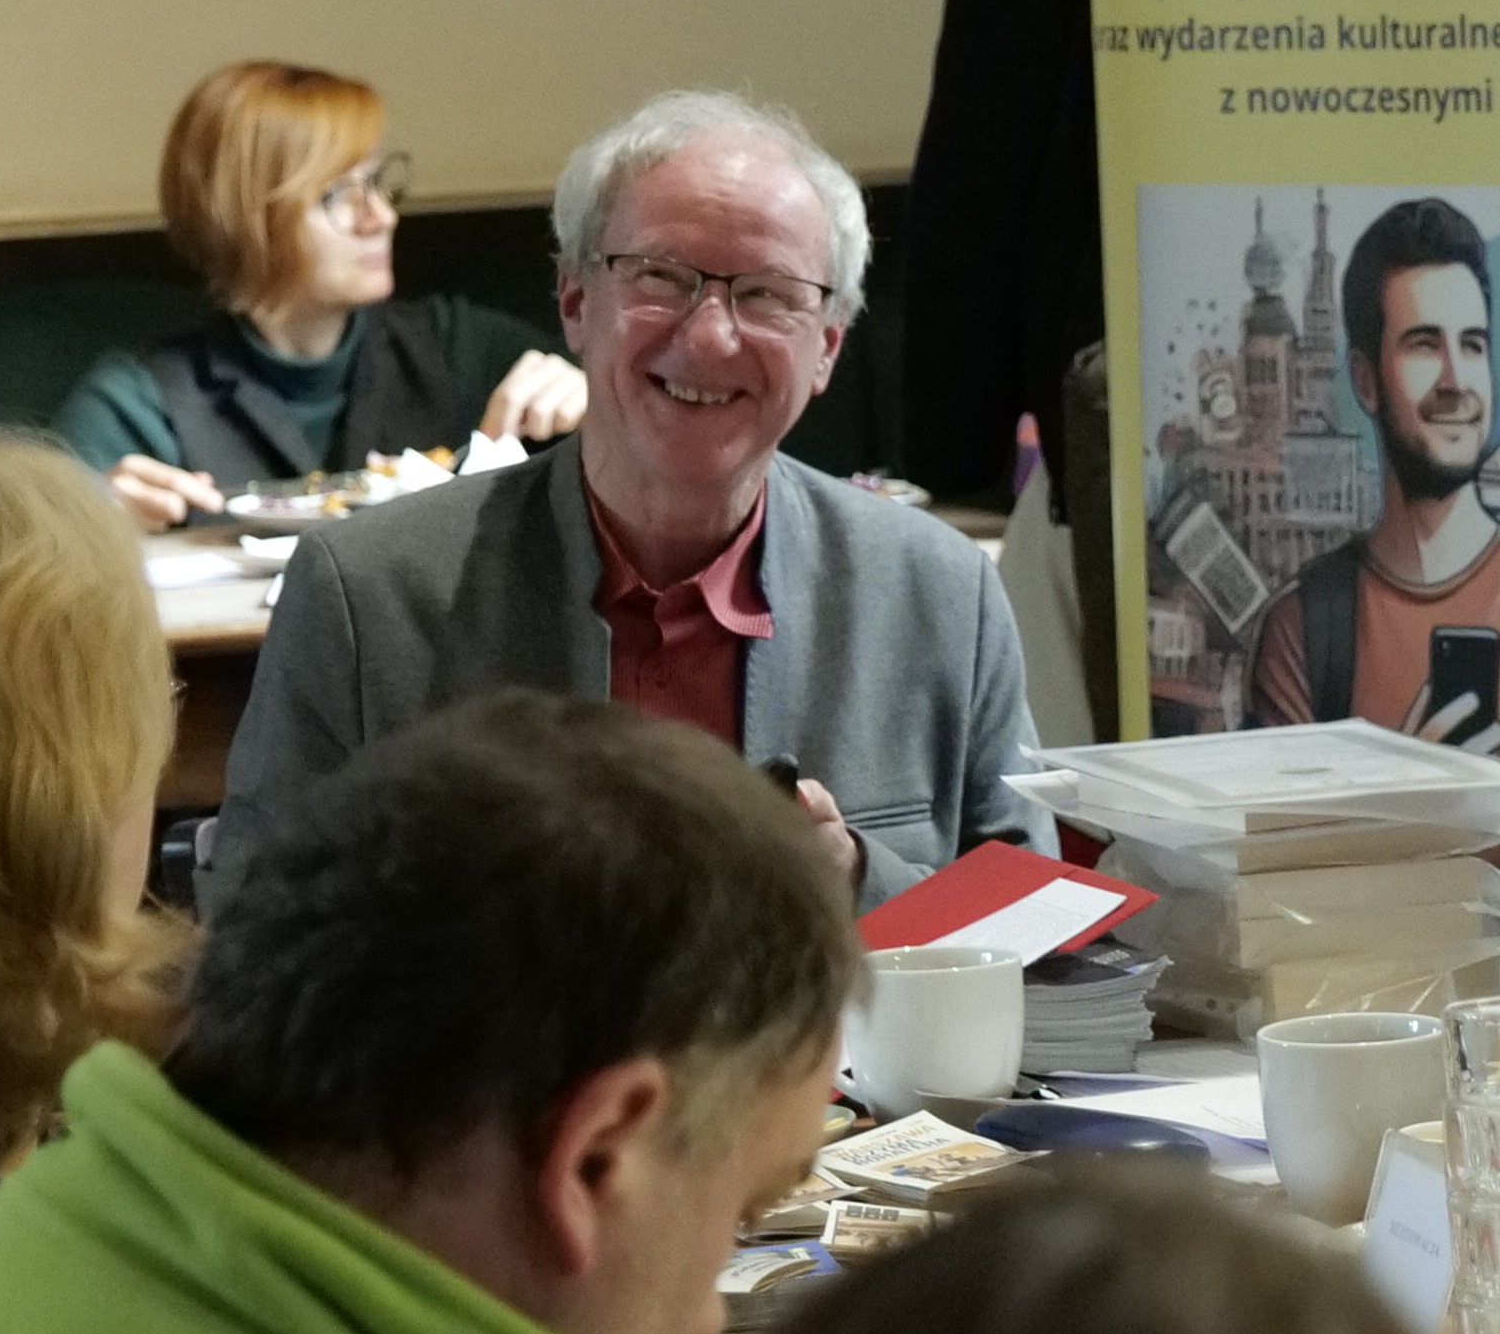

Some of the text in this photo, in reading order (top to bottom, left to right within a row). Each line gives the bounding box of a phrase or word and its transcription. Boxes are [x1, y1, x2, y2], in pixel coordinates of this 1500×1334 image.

[1137, 17, 1325, 61] wydarzenia
[1220, 87, 1235, 113] z
[1247, 78, 1493, 123] nowoczesnymi
